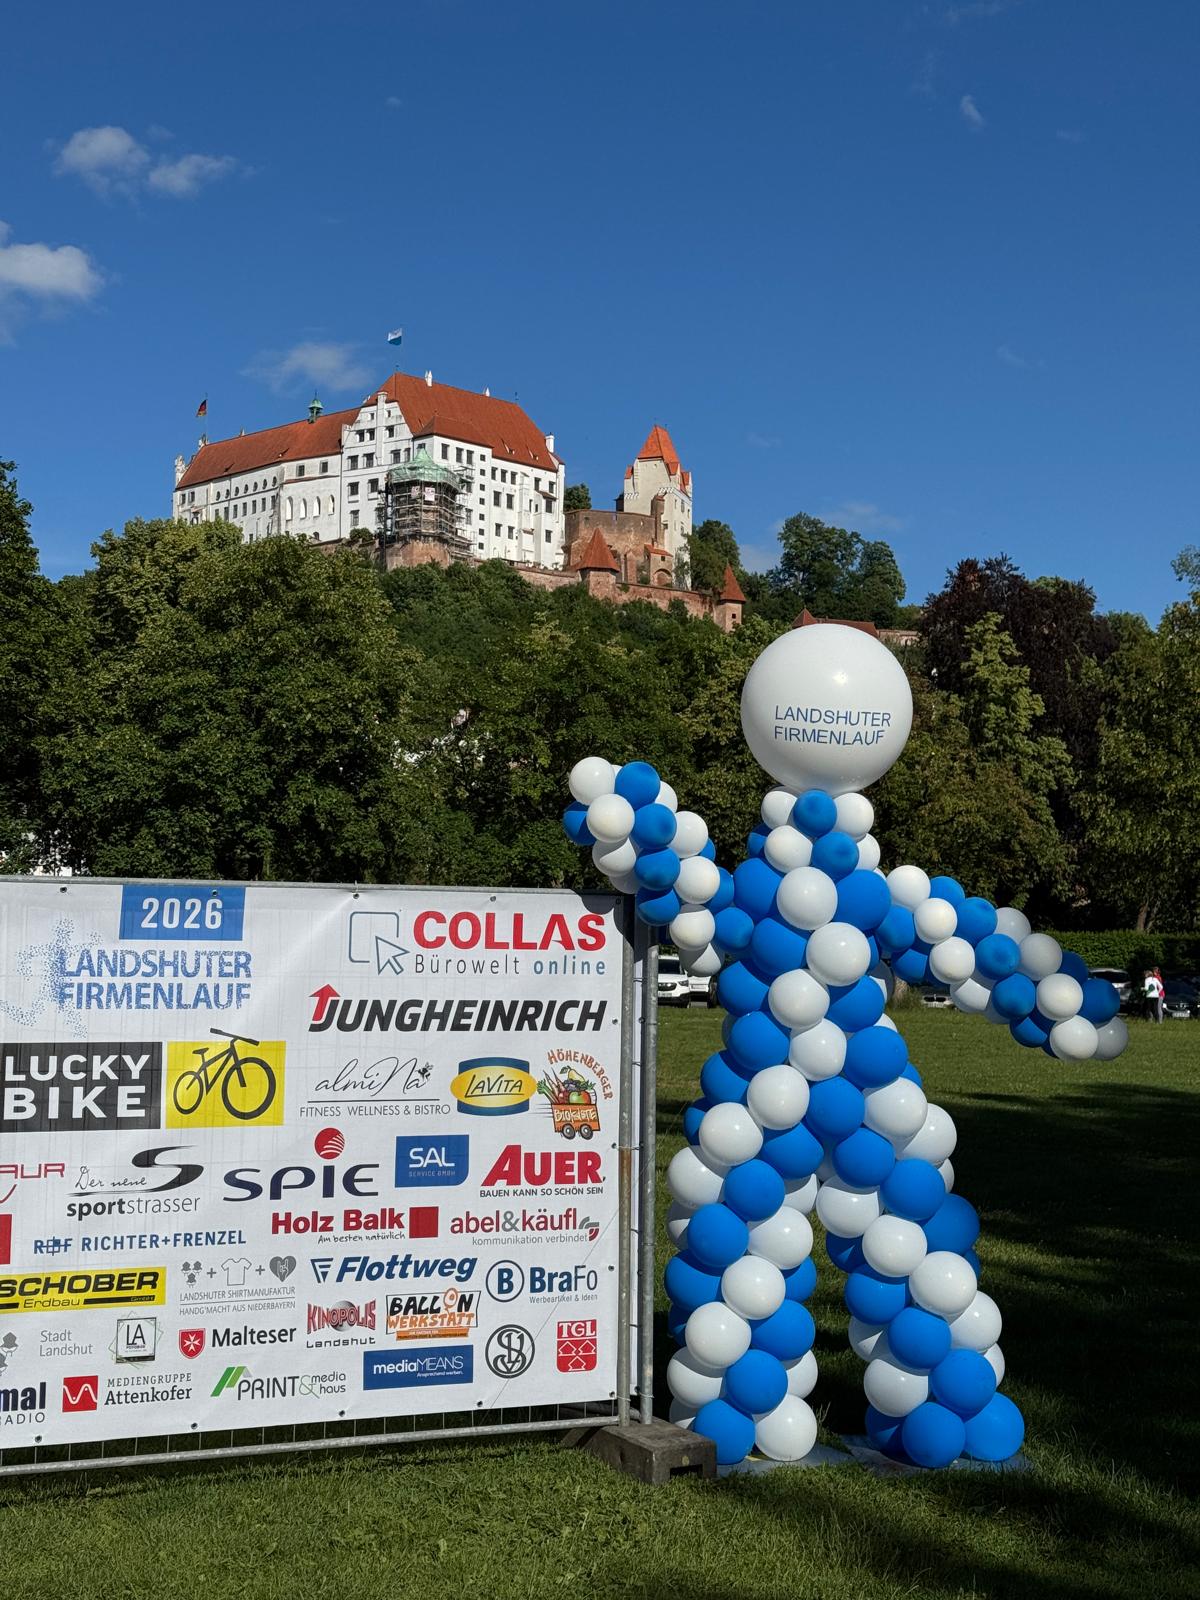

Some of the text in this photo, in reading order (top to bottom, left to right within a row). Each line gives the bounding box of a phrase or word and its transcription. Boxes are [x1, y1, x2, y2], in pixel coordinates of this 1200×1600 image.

[775, 705, 891, 727] LANDSHUTER
[774, 725, 885, 745] FIRMENLAUF
[141, 898, 223, 929] 2026
[413, 910, 606, 951] COLLAS
[60, 950, 252, 978] LANDSHUTER
[415, 954, 606, 975] Bürowelt online
[60, 982, 251, 1010] FIRMENLAUF
[308, 997, 608, 1032] JUNGHEINRICH
[4, 1054, 150, 1081] LUCKY
[547, 1048, 613, 1100] HÖHENBERGER
[3, 1085, 146, 1120] BIKE
[300, 1103, 451, 1117] FITNESS WELLNESS & BISTRO
[408, 1147, 455, 1168] SAL
[480, 1145, 604, 1187] AUER
[75, 1165, 147, 1190] Der neue
[223, 1163, 379, 1202] SPIE
[480, 1186, 604, 1198] BAUEN KANN SO SCHÖN SEIN
[67, 1197, 200, 1221] sportstrasser
[271, 1208, 405, 1235] Holz Balk
[450, 1207, 577, 1234] abel&käufl
[82, 1230, 246, 1252] RICHTER+FRENZEL
[318, 1231, 406, 1245] Am besten natürlich
[472, 1233, 587, 1246] kommunikation verbindet
[336, 1254, 478, 1282] Flottweg
[0, 1271, 159, 1298] SCHOBER
[497, 1265, 598, 1294] B BraFo
[24, 1298, 80, 1309] Erdbau
[180, 1286, 296, 1301] LANDSHUTER SHIRTMANUFAKTUR
[529, 1294, 573, 1303] Werbeartikel
[180, 1301, 296, 1316] HANDG'MACHT AUS NIEDERBAYERN
[307, 1299, 376, 1334] KINOPOLIS
[387, 1312, 475, 1329] WERKSTATT
[559, 1321, 596, 1338] TGL
[40, 1329, 72, 1343] Stadt
[127, 1324, 146, 1345] LA
[211, 1326, 297, 1347] Malteser
[306, 1336, 376, 1348] Landshut
[40, 1344, 93, 1357] Landshut
[373, 1356, 464, 1374] mediaMEANS
[107, 1373, 192, 1388] MEDIENGRUPPE
[238, 1376, 299, 1400] PRINT
[311, 1371, 346, 1383] media
[319, 1383, 346, 1393] haus
[104, 1385, 192, 1406] Attenkofer
[0, 1412, 45, 1425] ADIO
